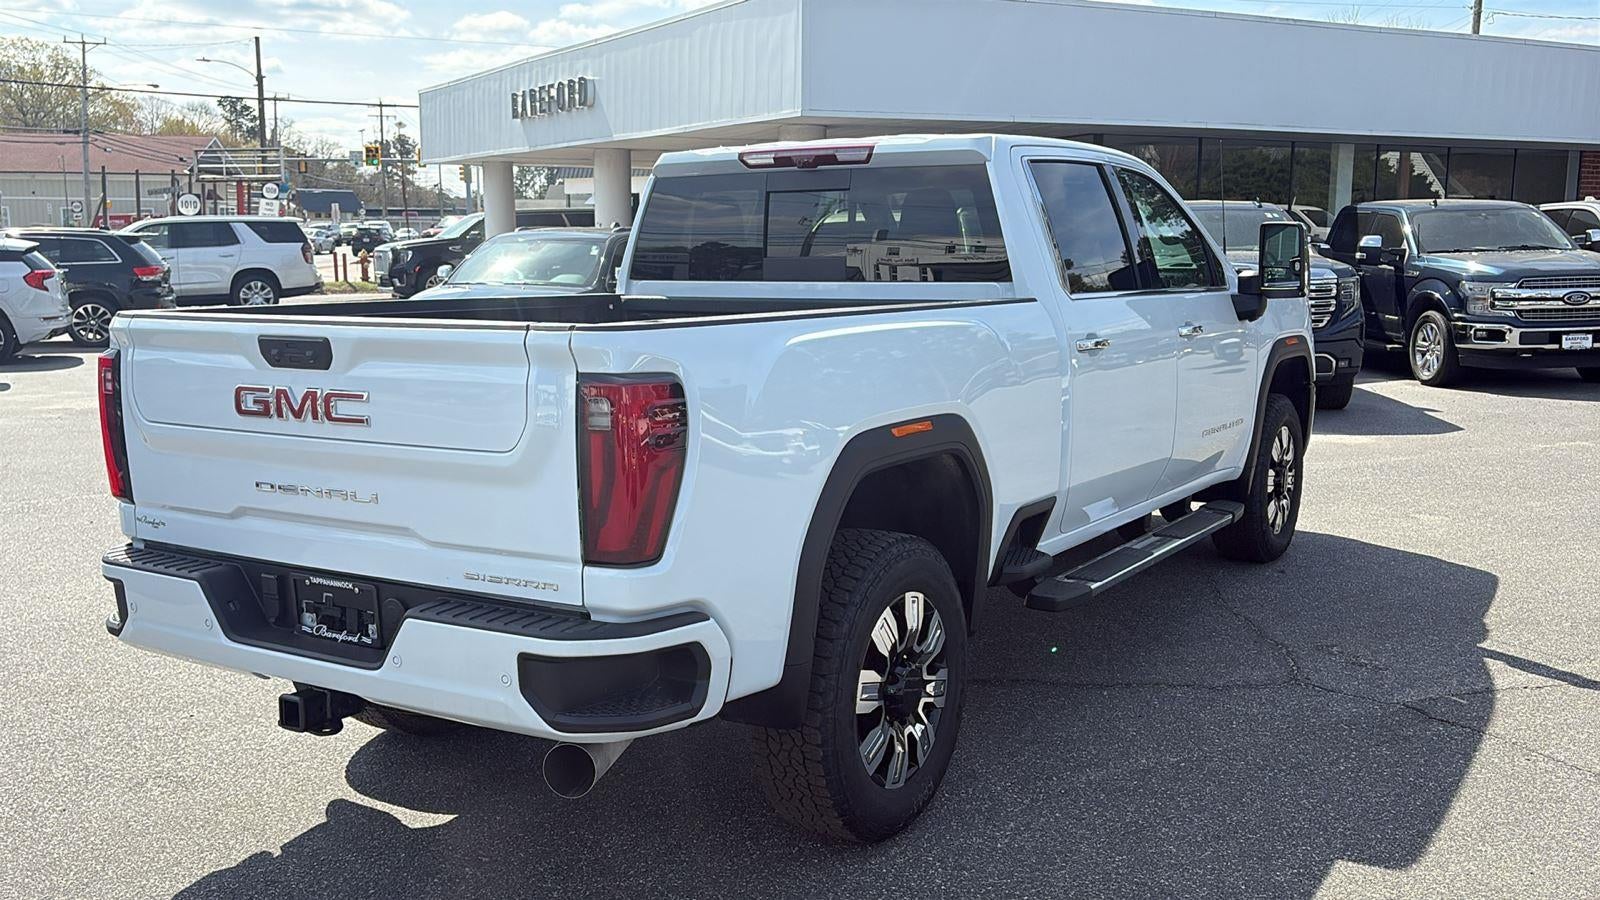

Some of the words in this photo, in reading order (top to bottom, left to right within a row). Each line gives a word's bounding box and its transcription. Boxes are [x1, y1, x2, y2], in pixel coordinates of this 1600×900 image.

[511, 76, 595, 119] BAREFORD
[180, 200, 198, 209] 1010
[233, 384, 371, 427] GMC
[255, 481, 379, 505] DENALI
[310, 576, 354, 590] TAPPAHANNOCK
[463, 571, 559, 592] SIERRA
[313, 624, 361, 643] Bareford
